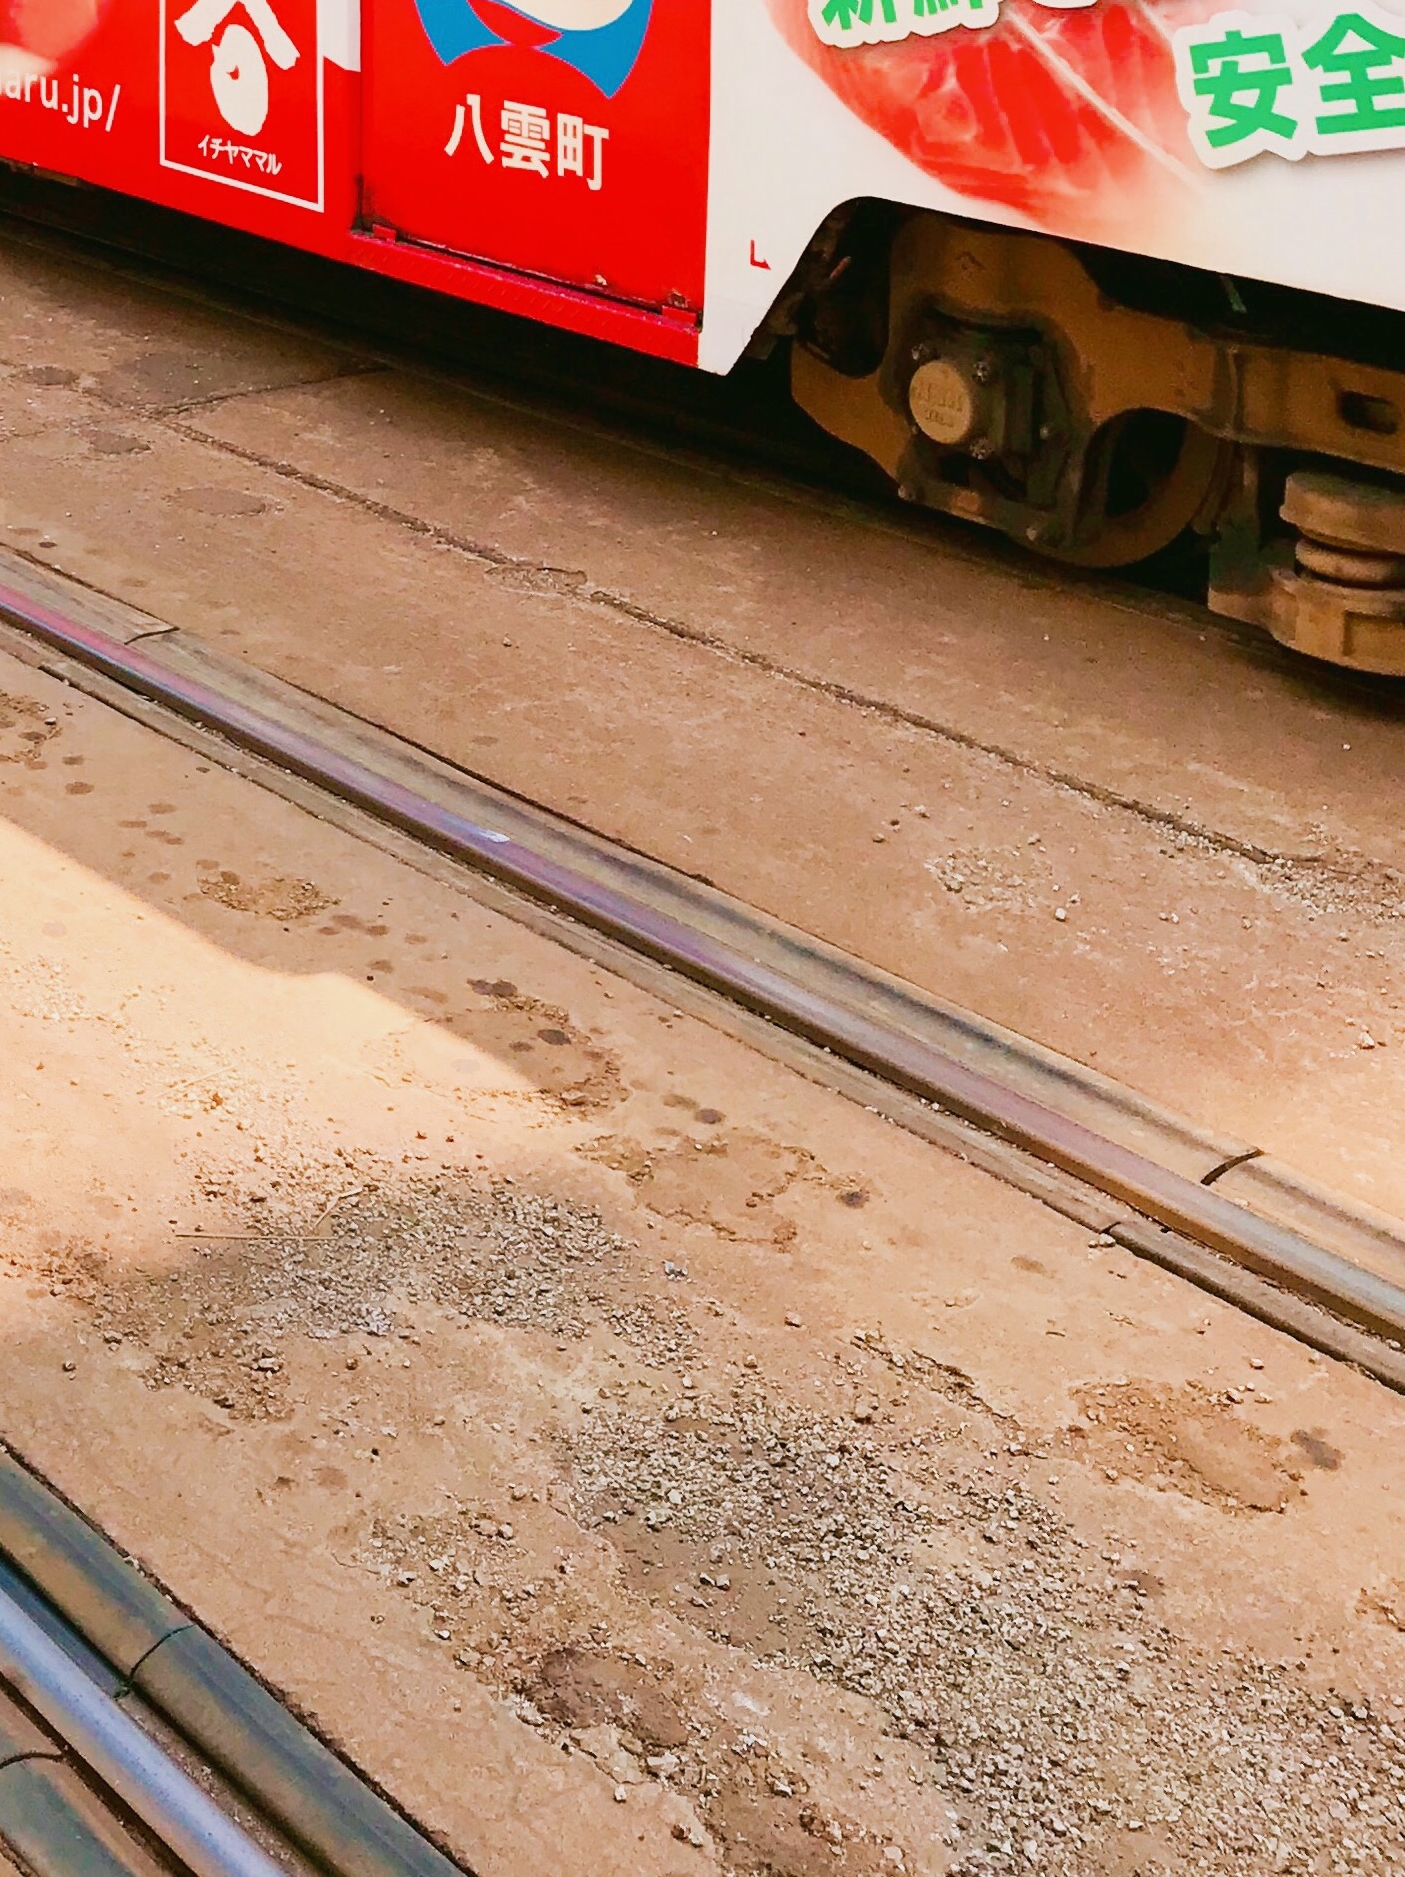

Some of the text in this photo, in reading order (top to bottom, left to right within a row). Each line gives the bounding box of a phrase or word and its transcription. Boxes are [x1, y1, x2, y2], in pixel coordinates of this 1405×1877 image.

[196, 133, 283, 178] イチヤママル
[443, 92, 611, 191] 八雲町
